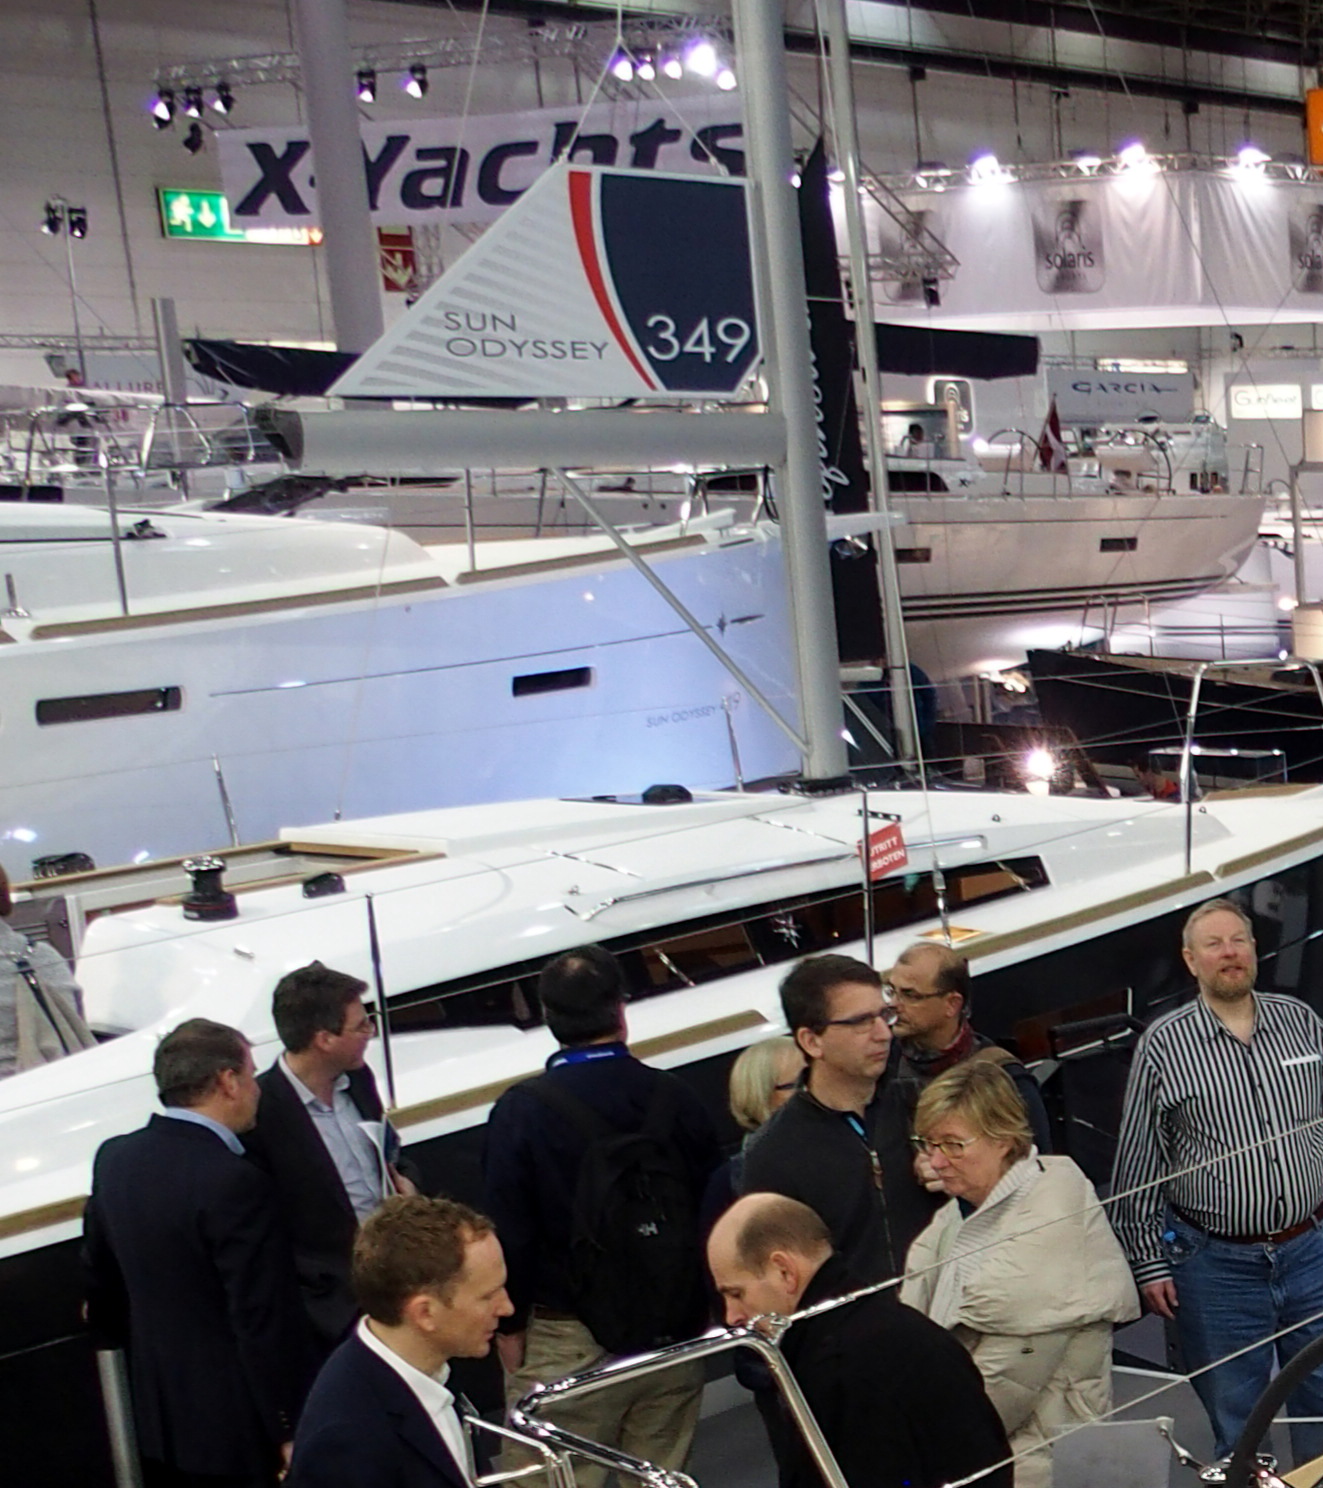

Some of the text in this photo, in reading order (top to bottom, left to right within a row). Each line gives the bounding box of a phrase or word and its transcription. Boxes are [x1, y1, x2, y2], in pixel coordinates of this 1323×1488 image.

[444, 311, 517, 333] SUN
[446, 337, 609, 360] ODYSSEY
[646, 314, 751, 364] 349
